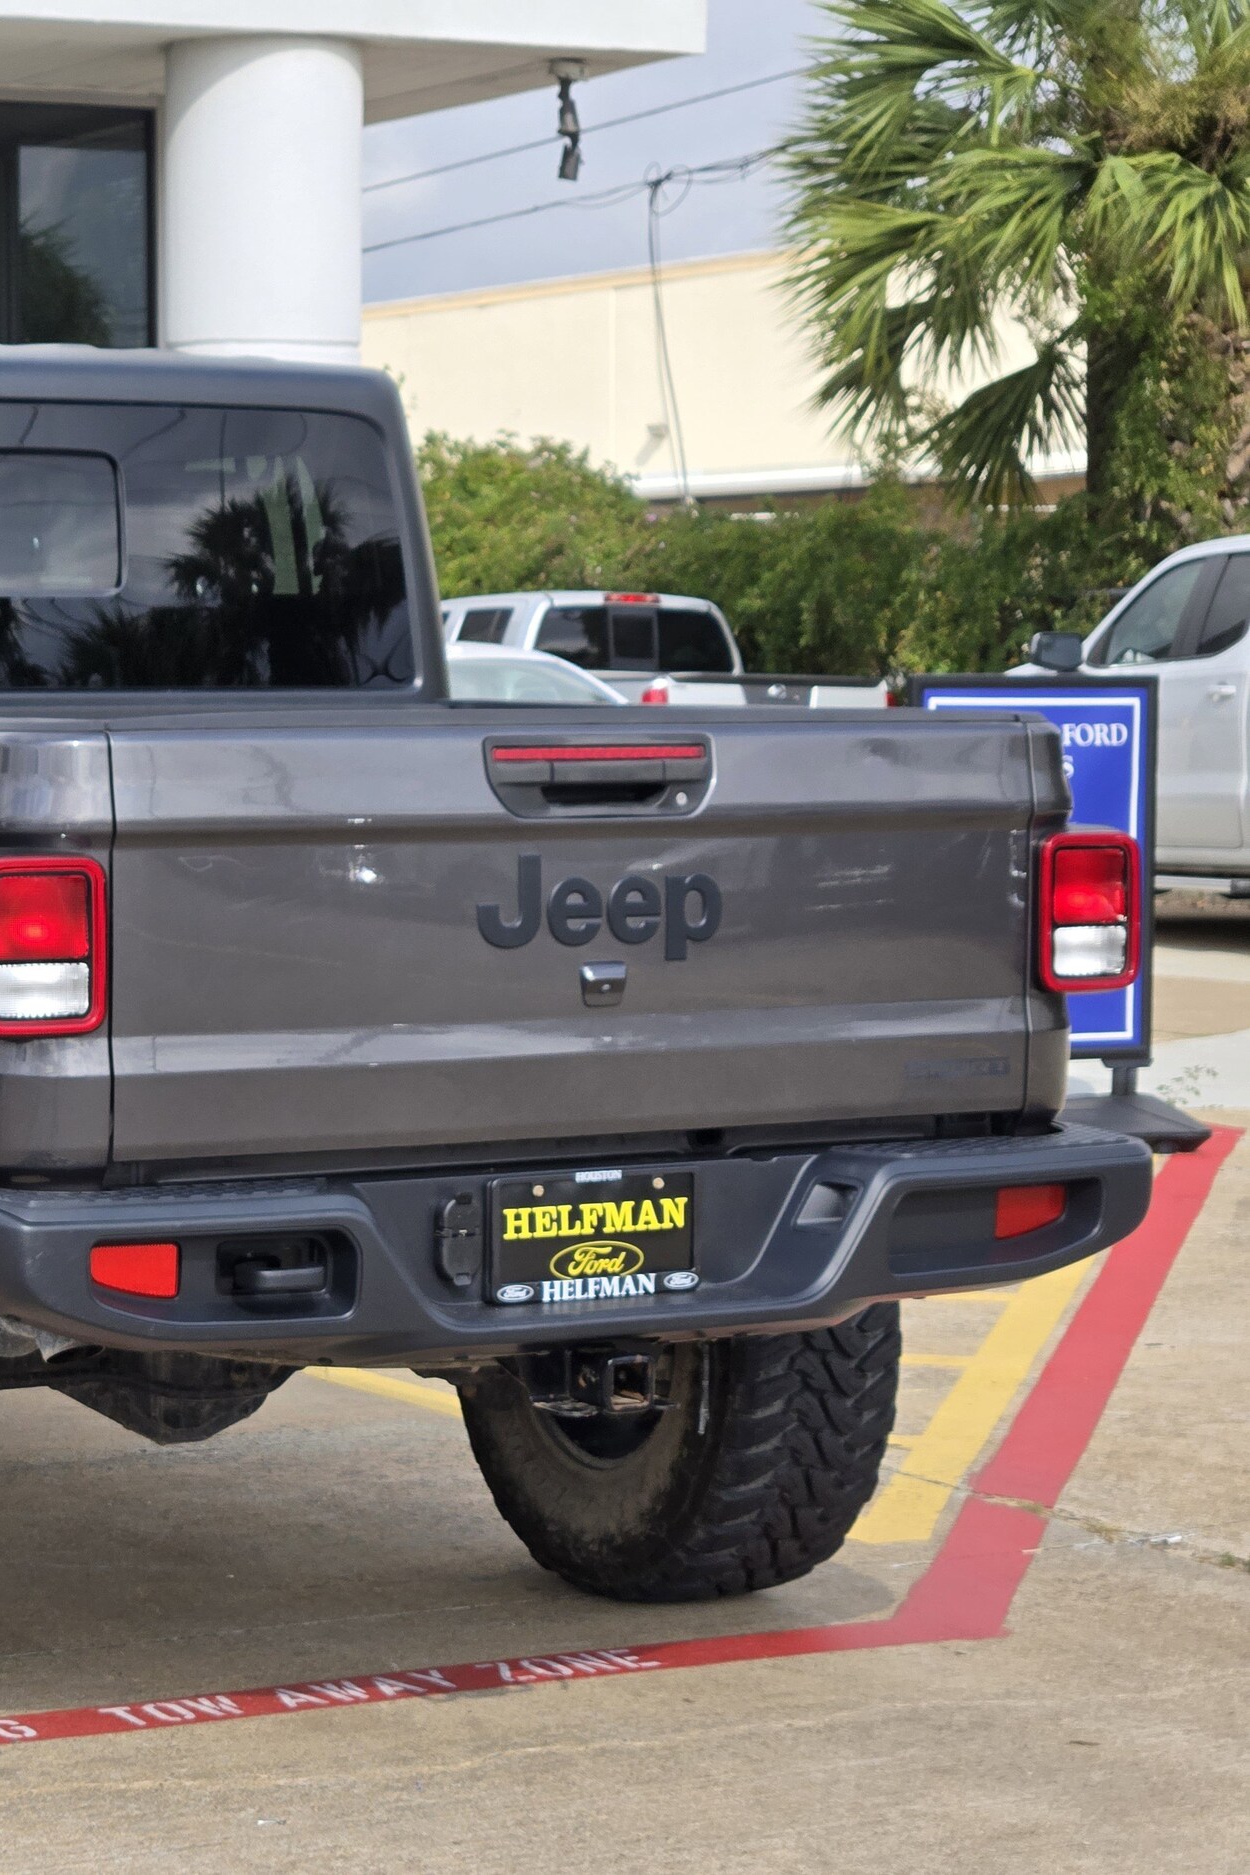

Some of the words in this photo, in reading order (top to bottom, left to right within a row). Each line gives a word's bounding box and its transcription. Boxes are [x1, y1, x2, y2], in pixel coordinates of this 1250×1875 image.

[476, 854, 722, 961] Jeep
[503, 1197, 688, 1240] HELFMAN
[567, 1246, 627, 1276] Ford
[542, 1273, 656, 1303] HELFMAN
[98, 1695, 243, 1727] TOW
[274, 1669, 457, 1708] AWAY
[474, 1648, 660, 1683] ZONE
